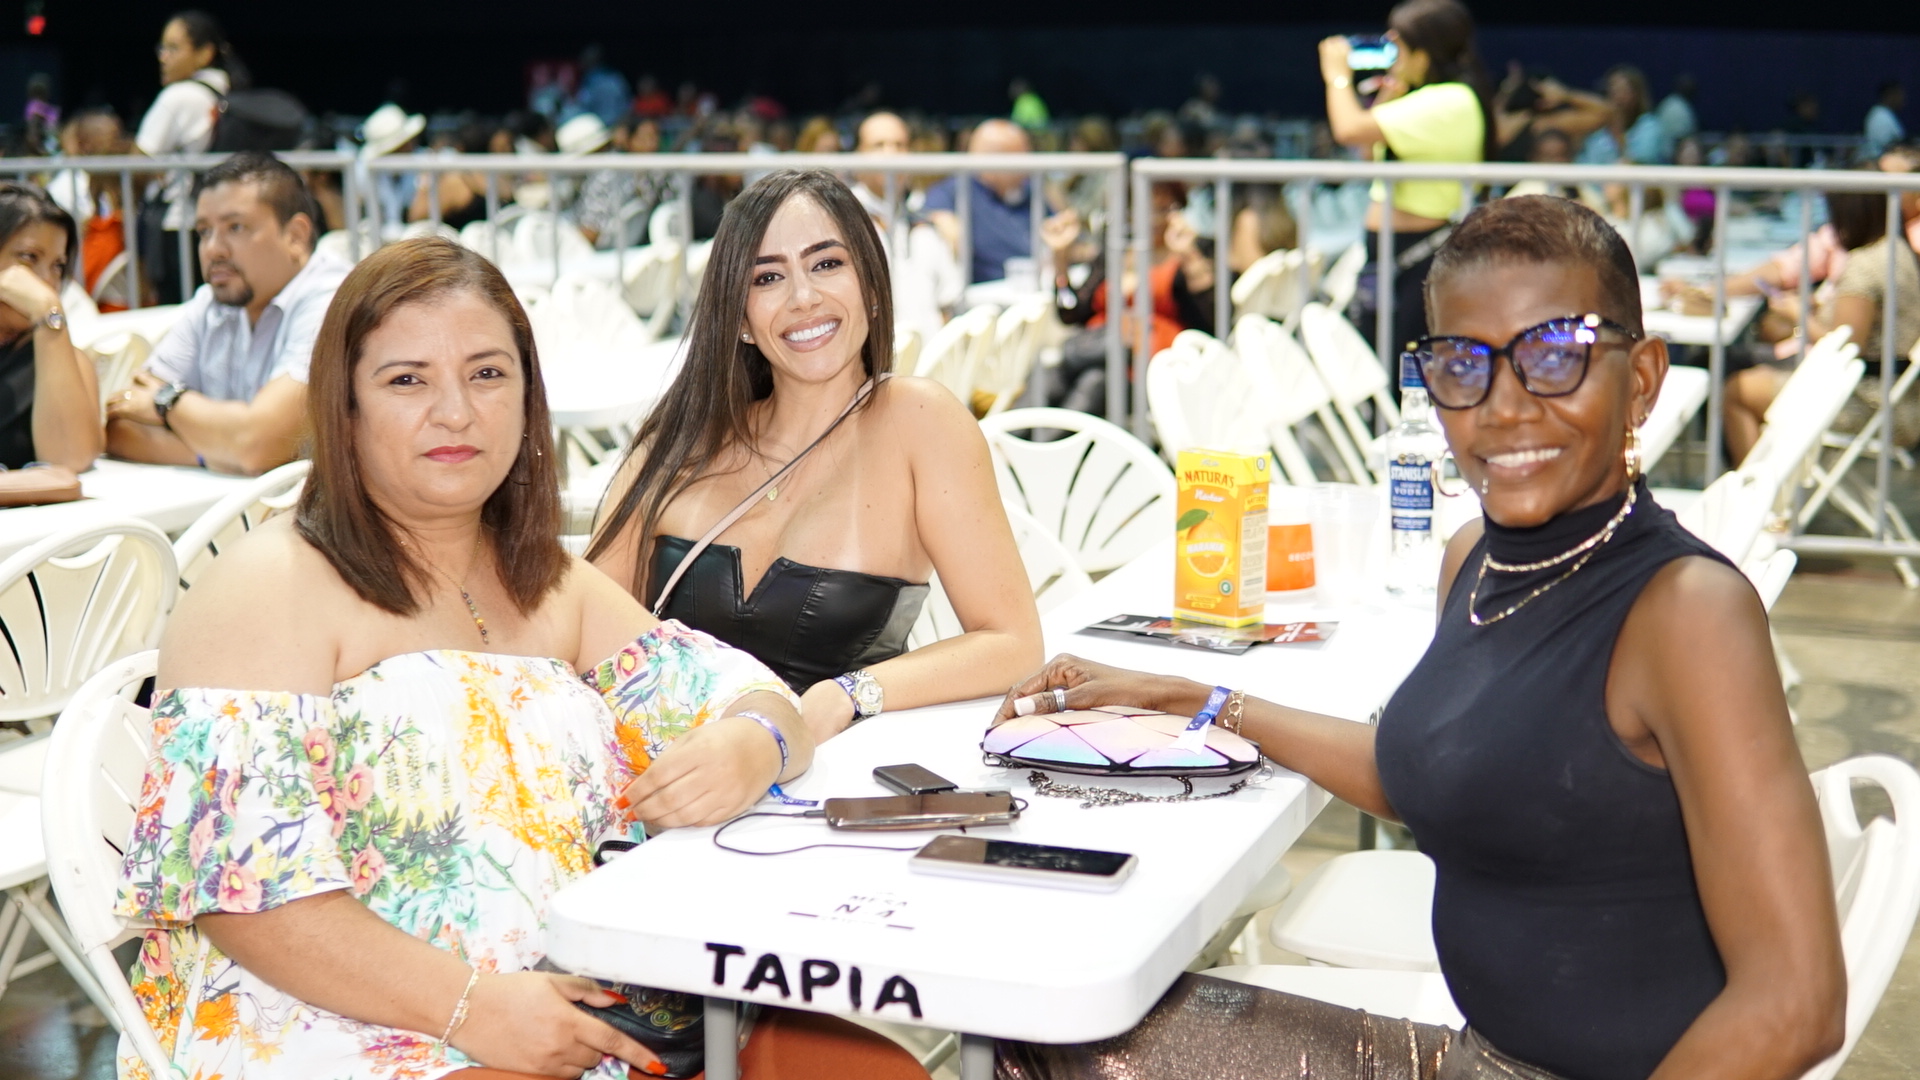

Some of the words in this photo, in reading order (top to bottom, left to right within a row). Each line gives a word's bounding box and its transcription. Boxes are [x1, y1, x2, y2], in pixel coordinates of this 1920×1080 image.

[1184, 470, 1235, 489] NATURA'S
[1394, 486, 1428, 496] VODKA
[704, 942, 923, 1019] TAPIA
